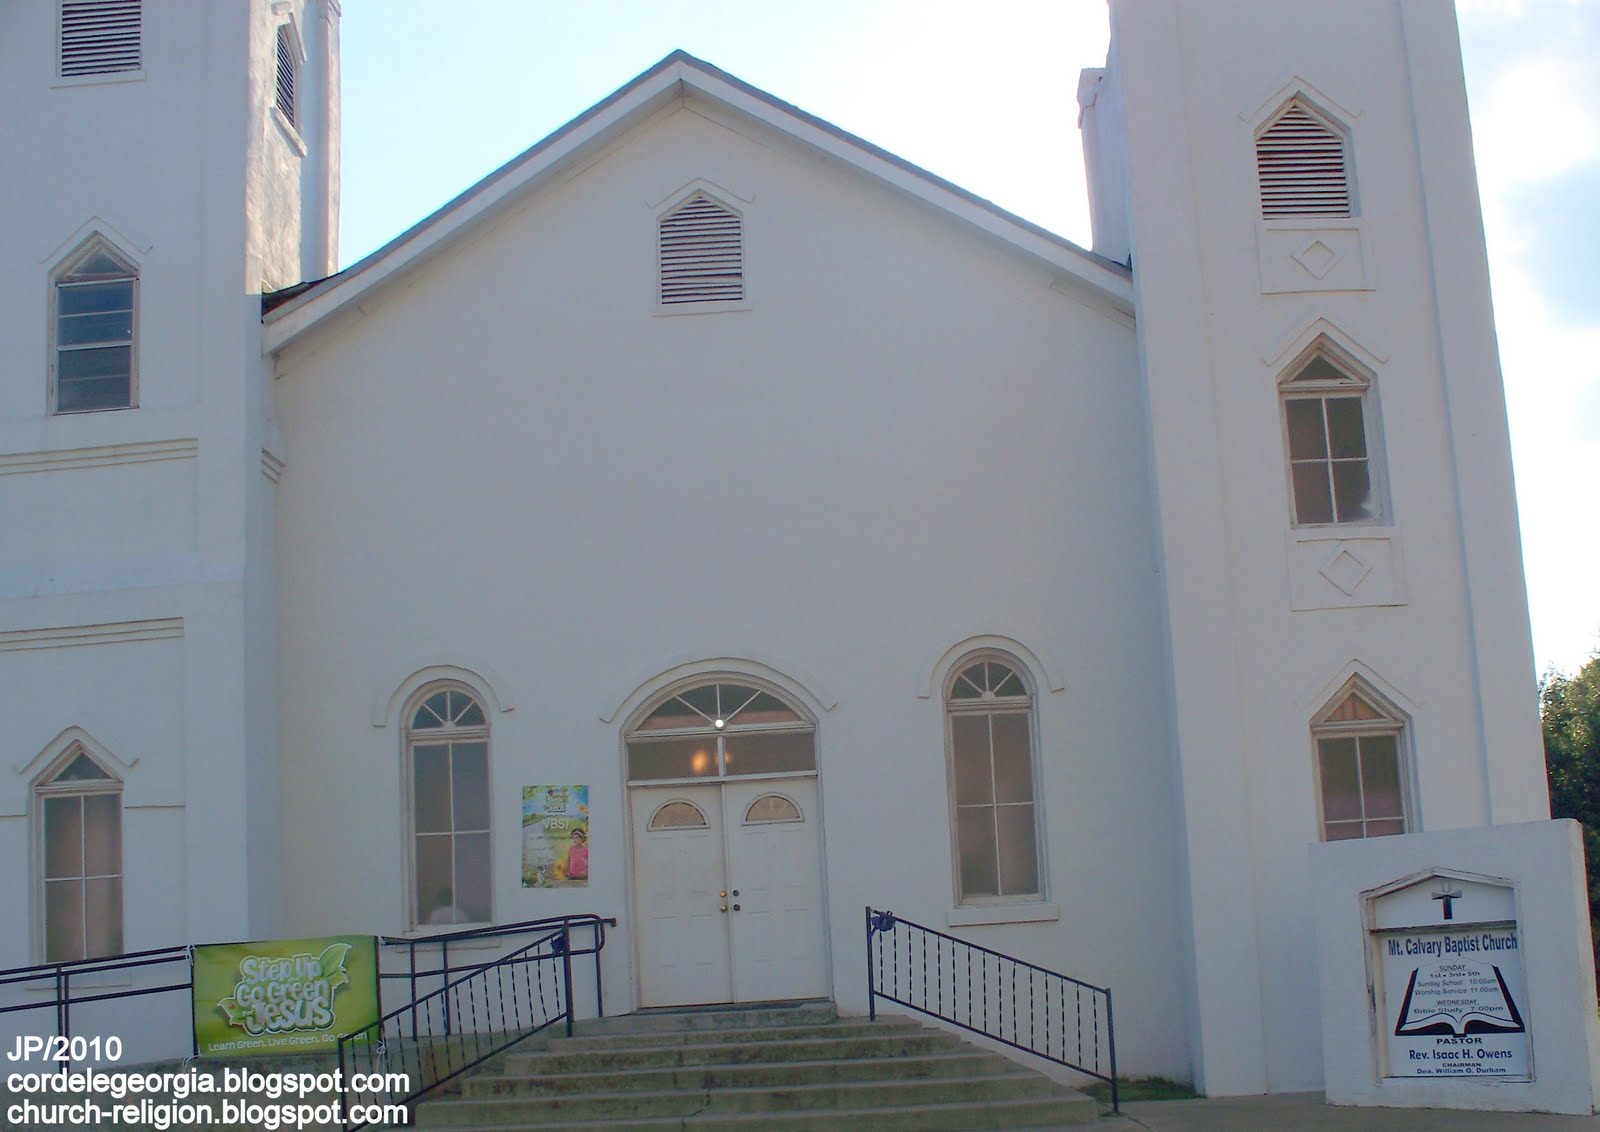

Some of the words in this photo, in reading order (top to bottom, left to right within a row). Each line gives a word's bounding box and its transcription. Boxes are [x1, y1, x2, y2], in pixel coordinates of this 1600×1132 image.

[1388, 939, 1404, 956] Mt.
[1406, 937, 1442, 958] Calvary
[1445, 935, 1480, 956] Baptist
[1482, 932, 1518, 951] Church
[243, 958, 293, 984] Step
[295, 956, 321, 980] Up
[1417, 980, 1440, 988] Sunday
[236, 984, 265, 1008] Go
[268, 979, 330, 1003] Green
[246, 996, 333, 1031] Jesus
[1438, 1006, 1464, 1014] Study
[208, 1039, 236, 1051] Learn
[237, 1039, 266, 1050] Green.
[268, 1038, 288, 1048] Live
[289, 1036, 319, 1046] Green.
[322, 1034, 336, 1042] Go
[1436, 1037, 1482, 1045] PASTOR
[1409, 1050, 1430, 1060] Rev.
[1432, 1049, 1460, 1060] Isaac
[1462, 1049, 1474, 1059] H.
[1476, 1048, 1513, 1059] Owens
